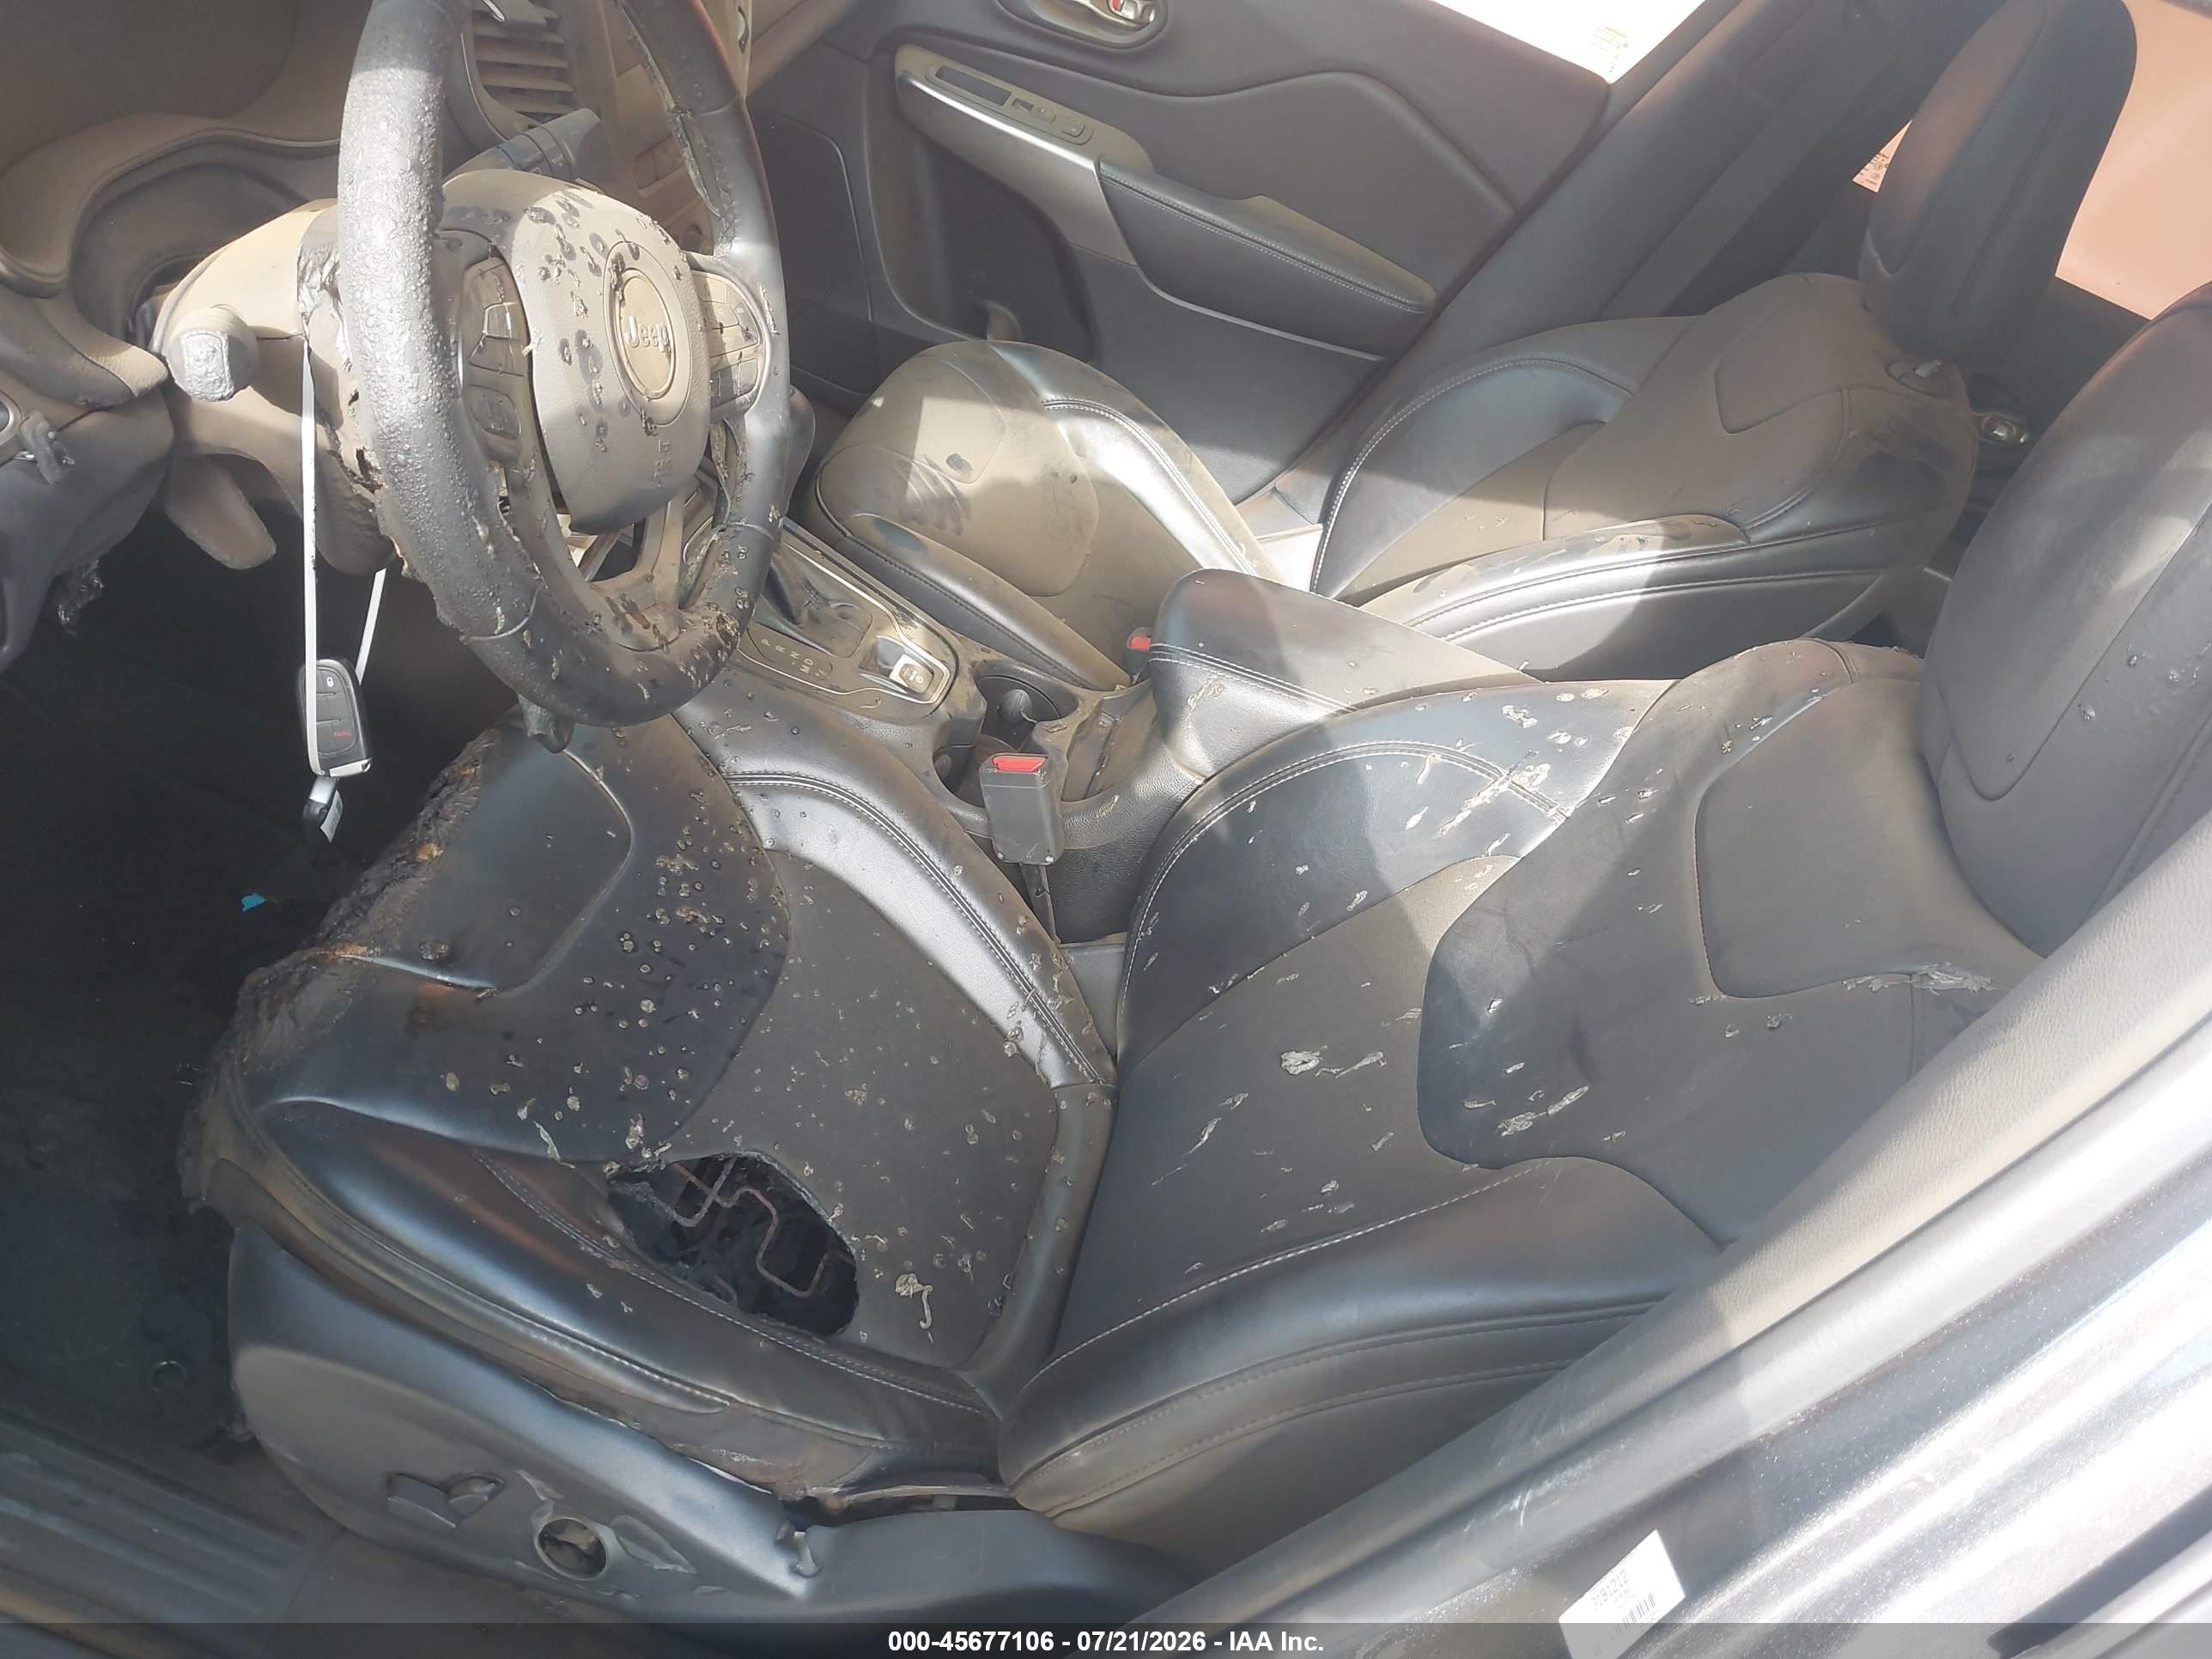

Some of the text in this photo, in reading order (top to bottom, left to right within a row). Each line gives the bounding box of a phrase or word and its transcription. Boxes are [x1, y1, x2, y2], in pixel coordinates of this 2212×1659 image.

[623, 315, 670, 353] Jeep
[789, 651, 801, 659] N
[799, 658, 814, 674] M D
